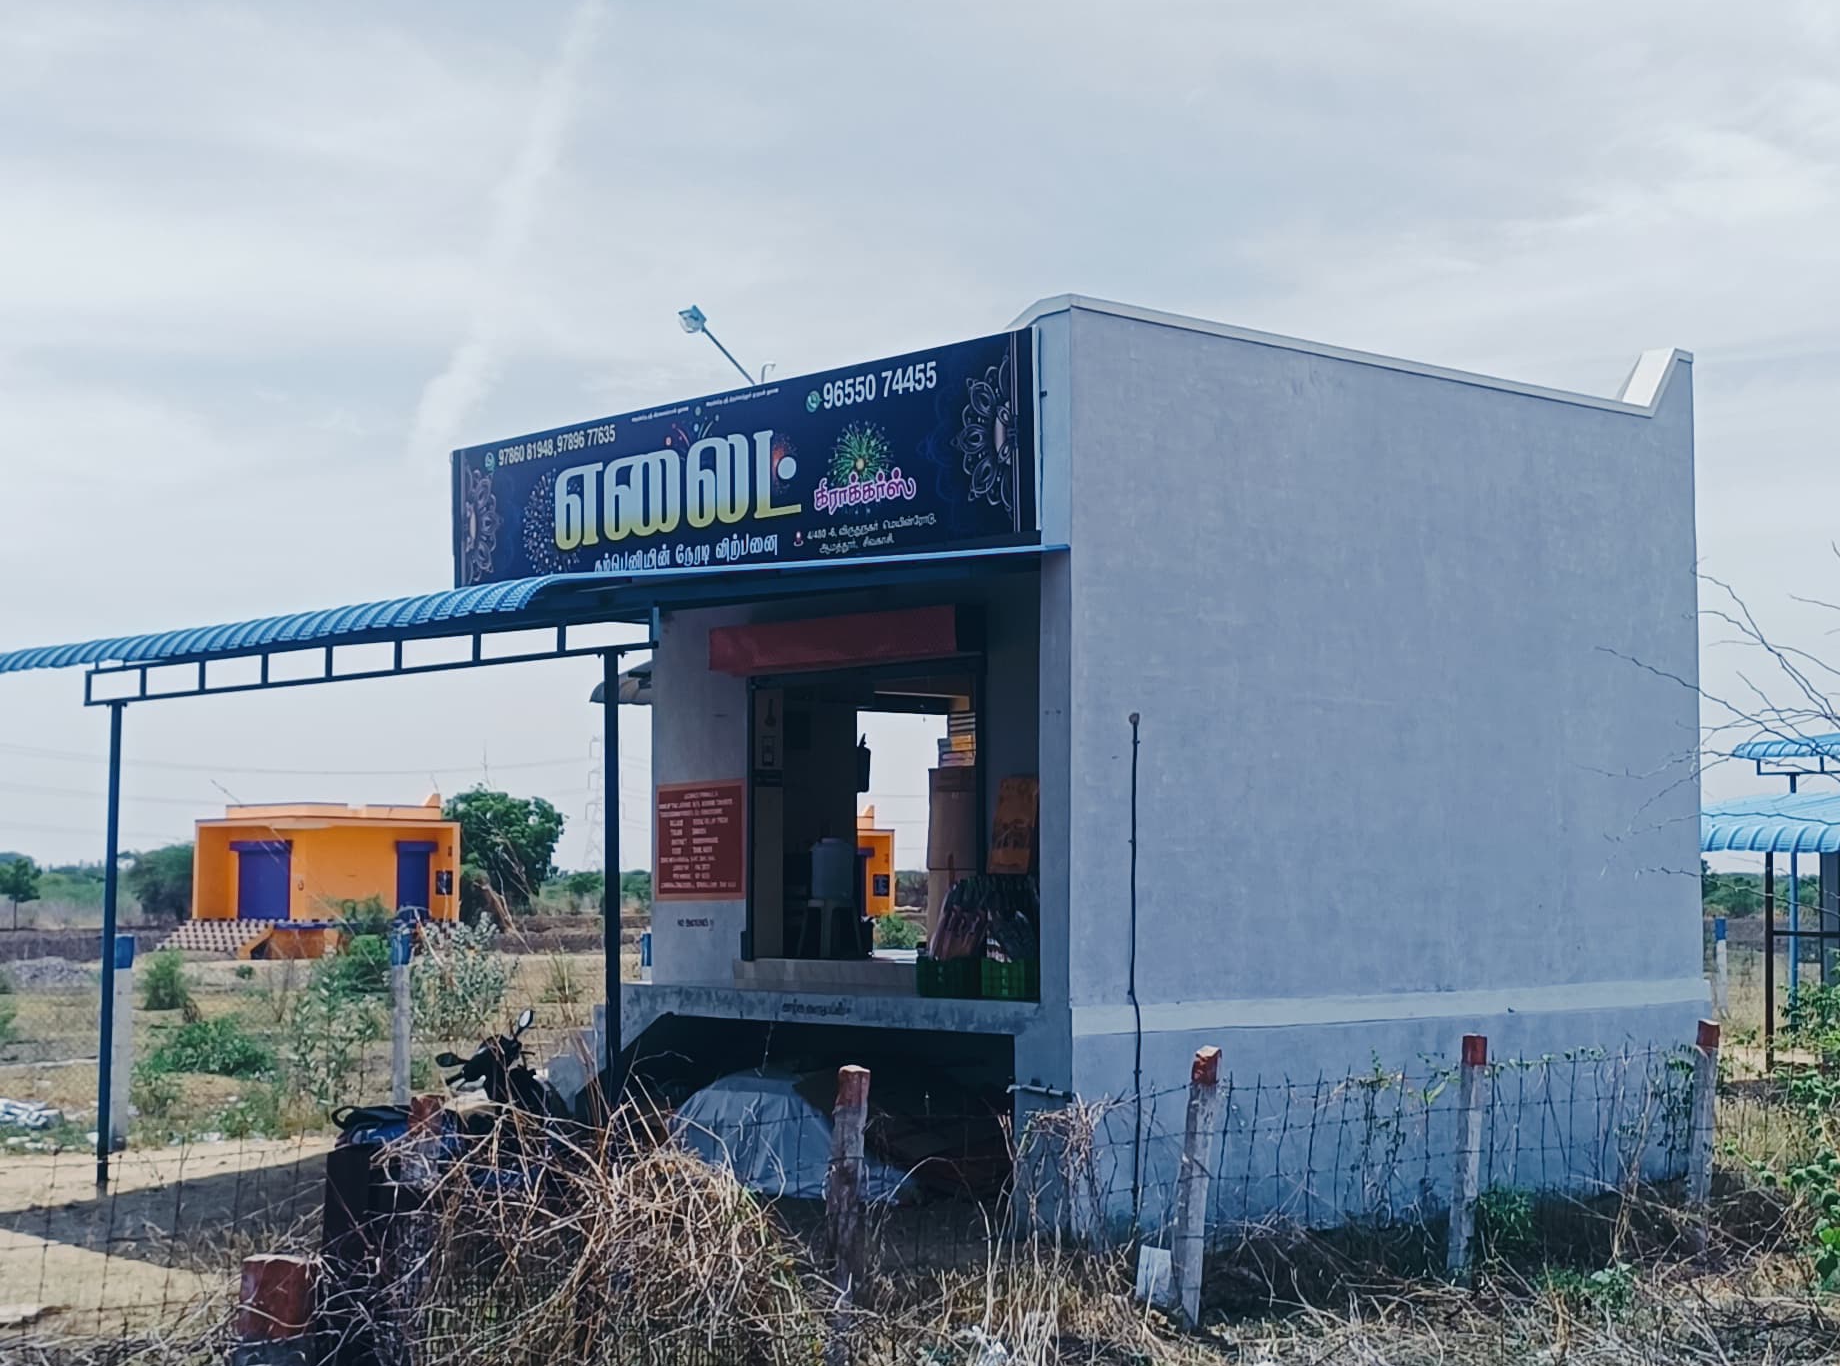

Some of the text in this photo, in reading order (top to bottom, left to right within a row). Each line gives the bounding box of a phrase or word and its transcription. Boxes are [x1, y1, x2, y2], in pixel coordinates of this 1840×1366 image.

[823, 373, 876, 409] 96550
[881, 361, 937, 398] 74455
[498, 445, 525, 466] 97860
[587, 424, 616, 447] 77635
[554, 429, 802, 550] எலைட்
[813, 466, 917, 515] கிராக்கர்ஸ்
[675, 543, 710, 567] நேரடி
[715, 532, 778, 562] விற்பனை
